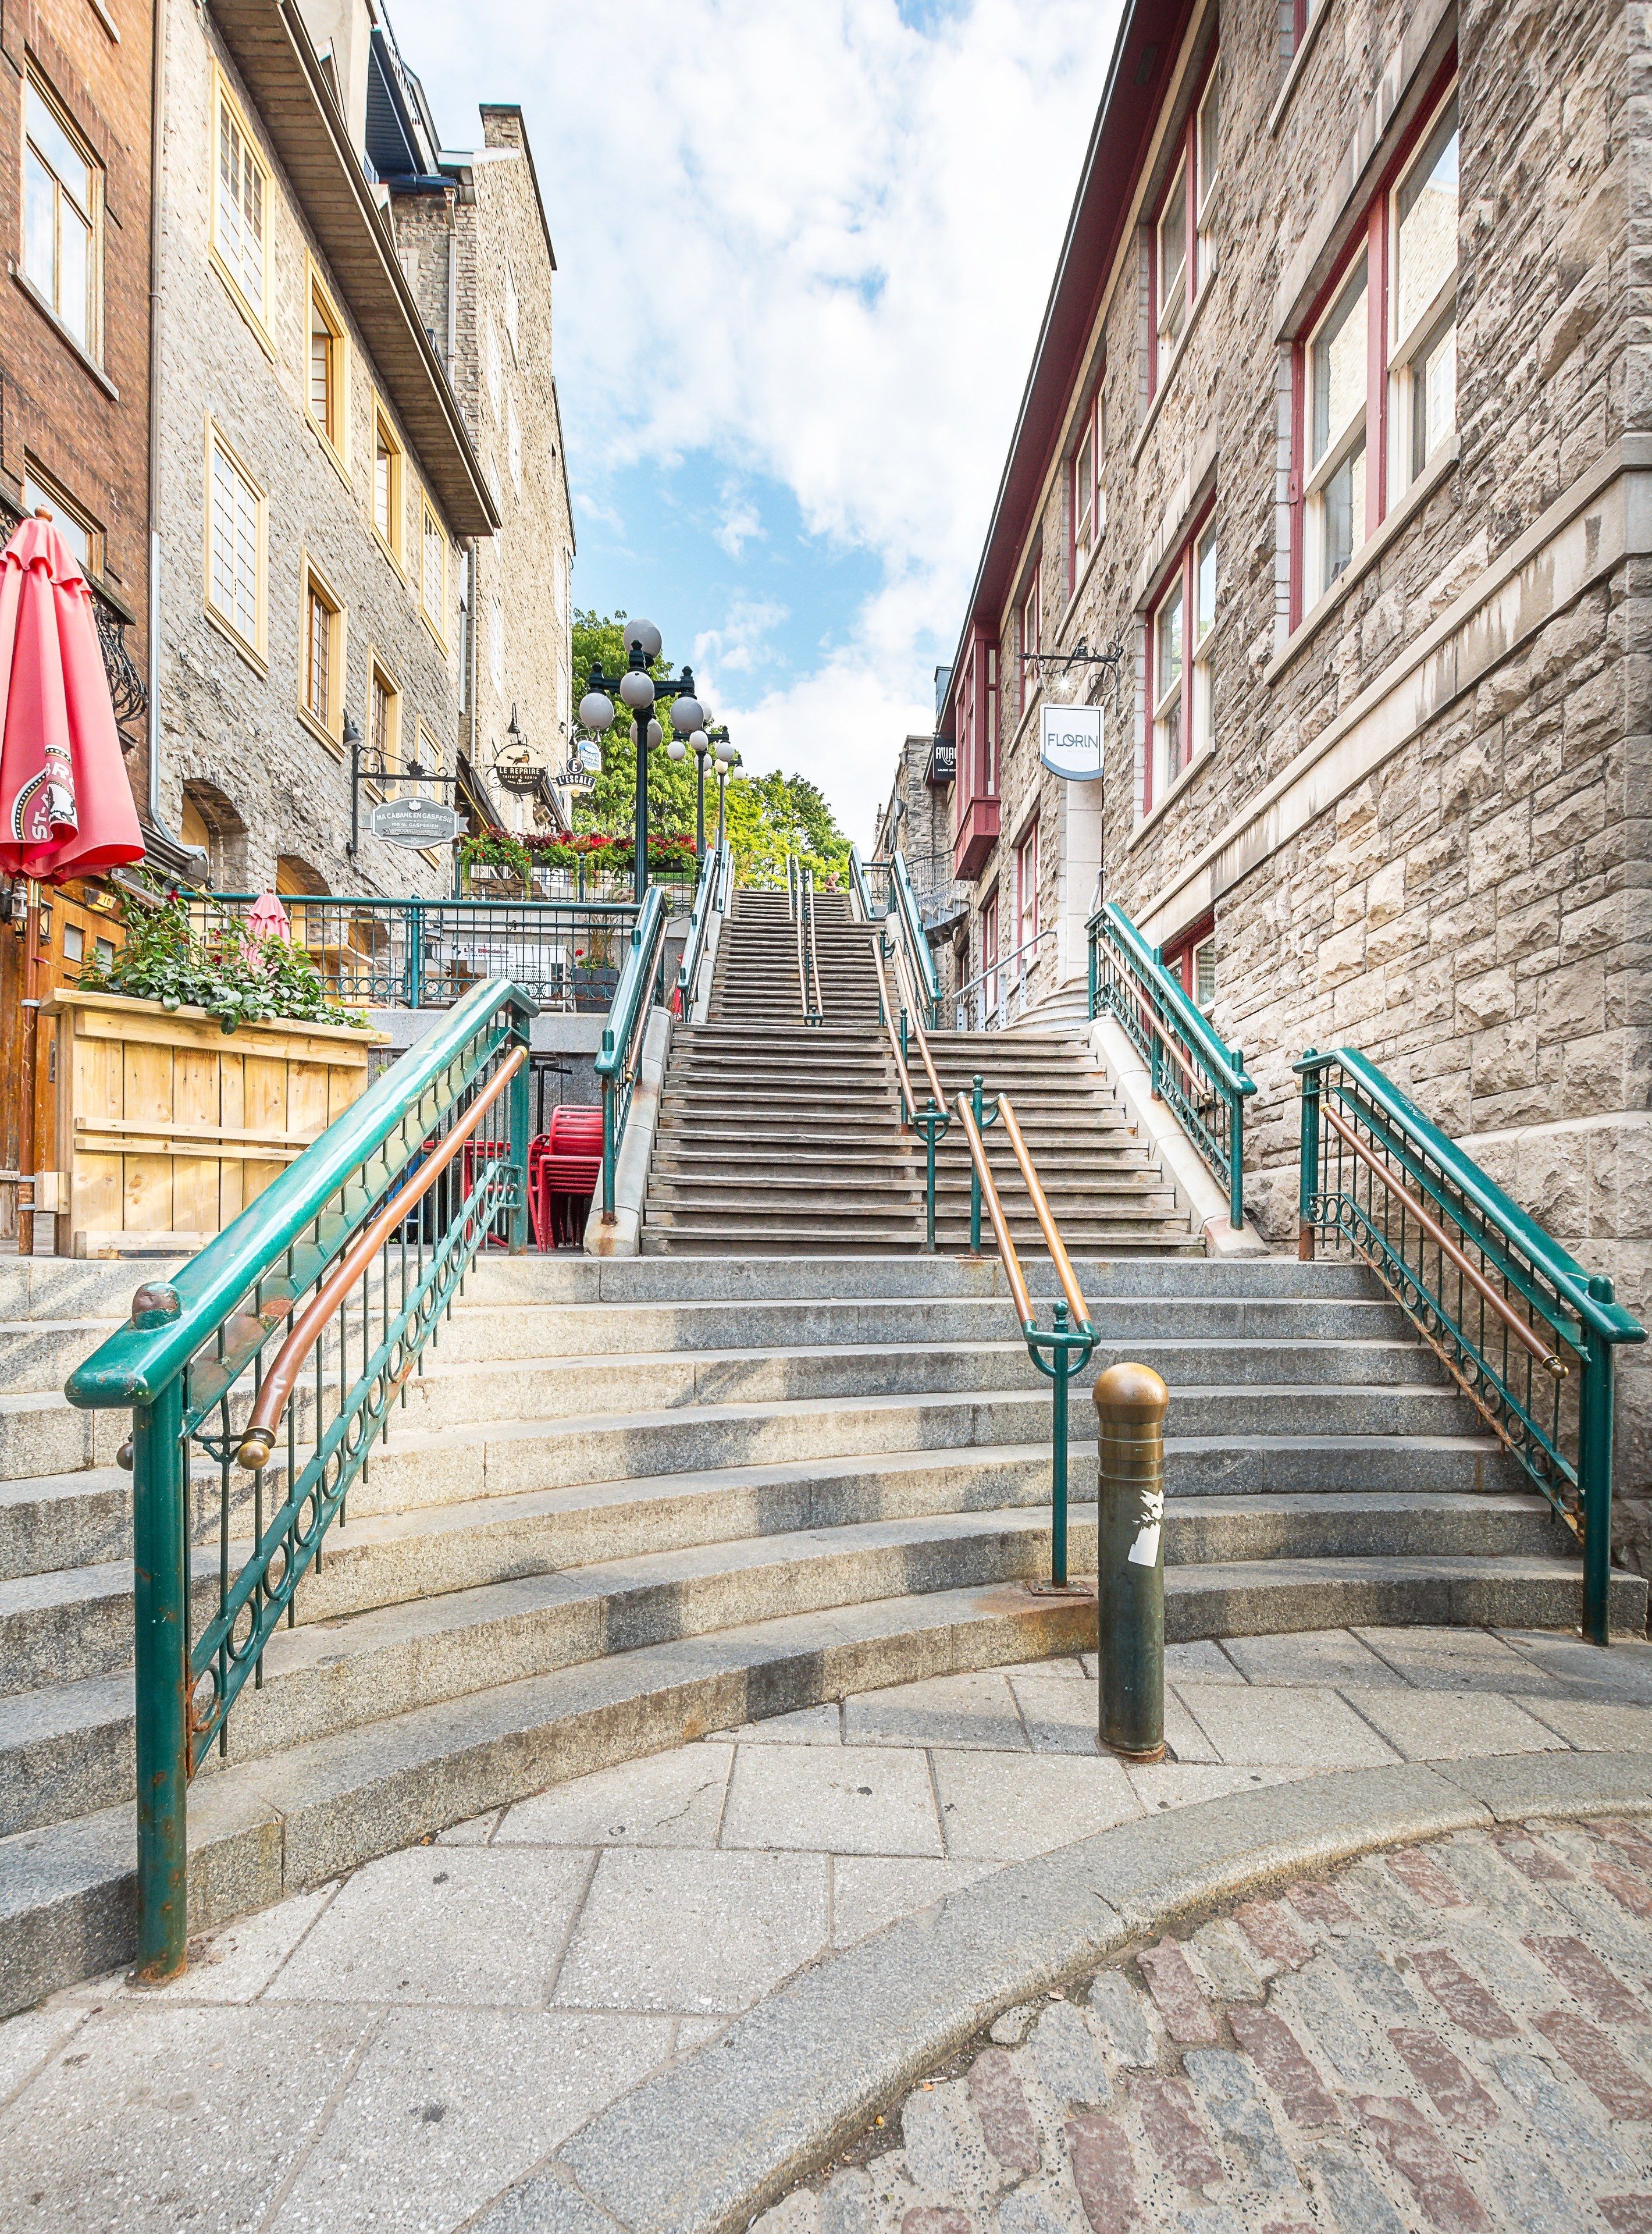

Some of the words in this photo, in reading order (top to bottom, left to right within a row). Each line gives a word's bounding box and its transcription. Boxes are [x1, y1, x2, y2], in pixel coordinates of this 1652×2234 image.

[1048, 733, 1098, 748] FLORIN
[510, 767, 540, 776] REPAIRE
[572, 760, 579, 772] E
[558, 775, 593, 786] L'ESCALE
[104, 897, 111, 905] 10
